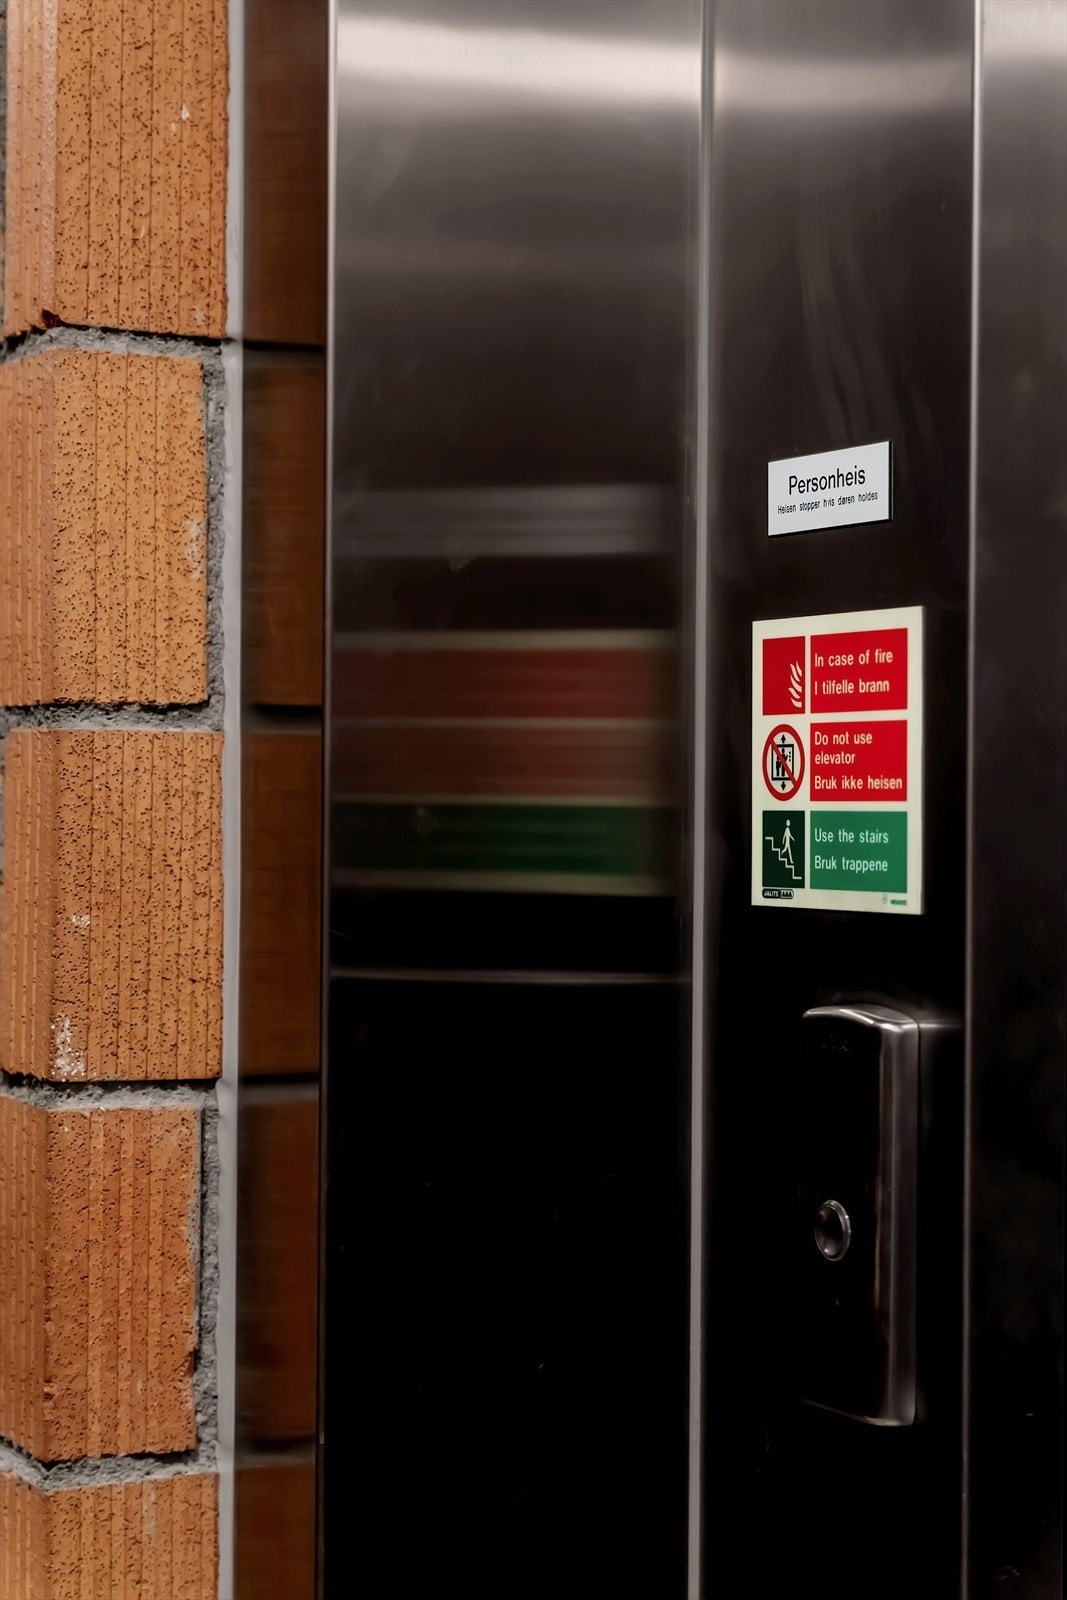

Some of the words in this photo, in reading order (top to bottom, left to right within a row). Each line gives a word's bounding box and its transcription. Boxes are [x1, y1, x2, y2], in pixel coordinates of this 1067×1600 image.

[789, 465, 866, 495] Personheis
[778, 504, 797, 515] Heisen
[799, 500, 821, 512] stopper
[823, 498, 835, 508] hvis
[838, 495, 855, 506] døren
[858, 491, 879, 503] holdes
[814, 653, 824, 668] In
[828, 654, 854, 667] case
[858, 649, 870, 665] of
[874, 648, 893, 664] fire
[815, 681, 818, 695] I
[822, 679, 855, 695] tilfelle
[859, 678, 890, 693] brann
[814, 731, 829, 746] Do
[832, 731, 850, 745] not
[853, 732, 873, 745] use
[814, 750, 856, 765] elevator
[814, 775, 838, 790] Bruk
[841, 774, 864, 790] ikke
[867, 774, 903, 790] heisen
[814, 828, 834, 842] Use
[838, 828, 855, 843] the
[859, 829, 889, 844] stairs
[814, 855, 838, 870] Bruk
[841, 856, 889, 874] trappene
